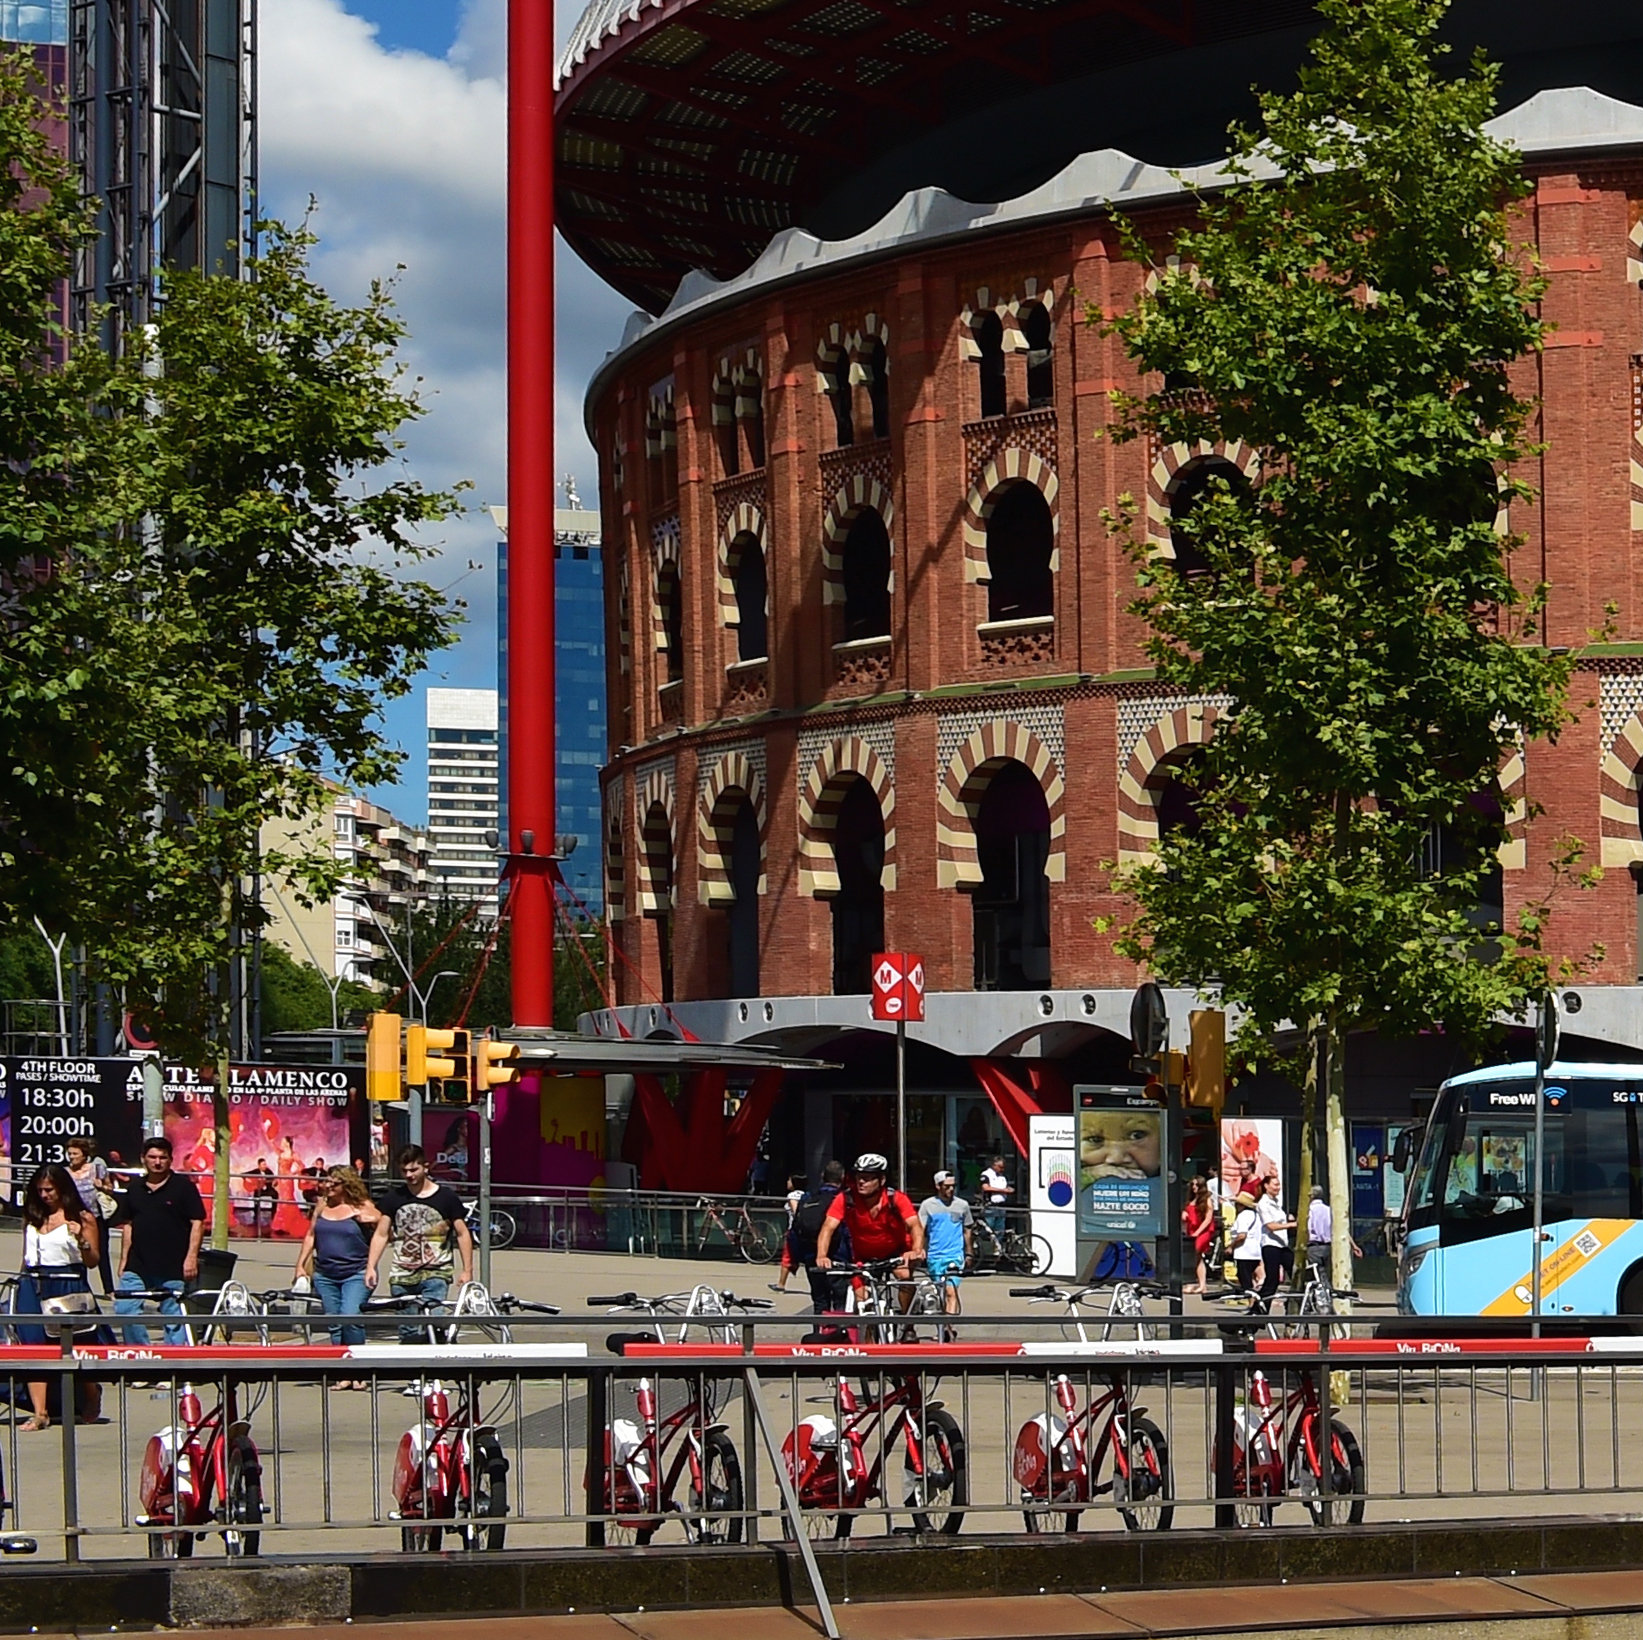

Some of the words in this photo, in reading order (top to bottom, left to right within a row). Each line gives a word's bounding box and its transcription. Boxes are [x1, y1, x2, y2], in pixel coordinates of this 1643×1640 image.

[880, 969, 891, 984] M
[21, 1061, 46, 1072] 4TH
[50, 1062, 96, 1074] FLOOR
[16, 1072, 43, 1081] PASES
[49, 1073, 102, 1083] SHOWTIME
[126, 1066, 200, 1083] ATE
[230, 1068, 348, 1089] LAMENCO
[22, 1088, 94, 1108] 18:30h
[126, 1091, 175, 1101] SHW
[184, 1093, 242, 1103] DIAO
[261, 1095, 302, 1105] DAILY
[308, 1096, 348, 1107] SHOW
[1490, 1093, 1519, 1105] Free
[1519, 1093, 1536, 1105] Wi
[20, 1116, 94, 1136] 20:00h
